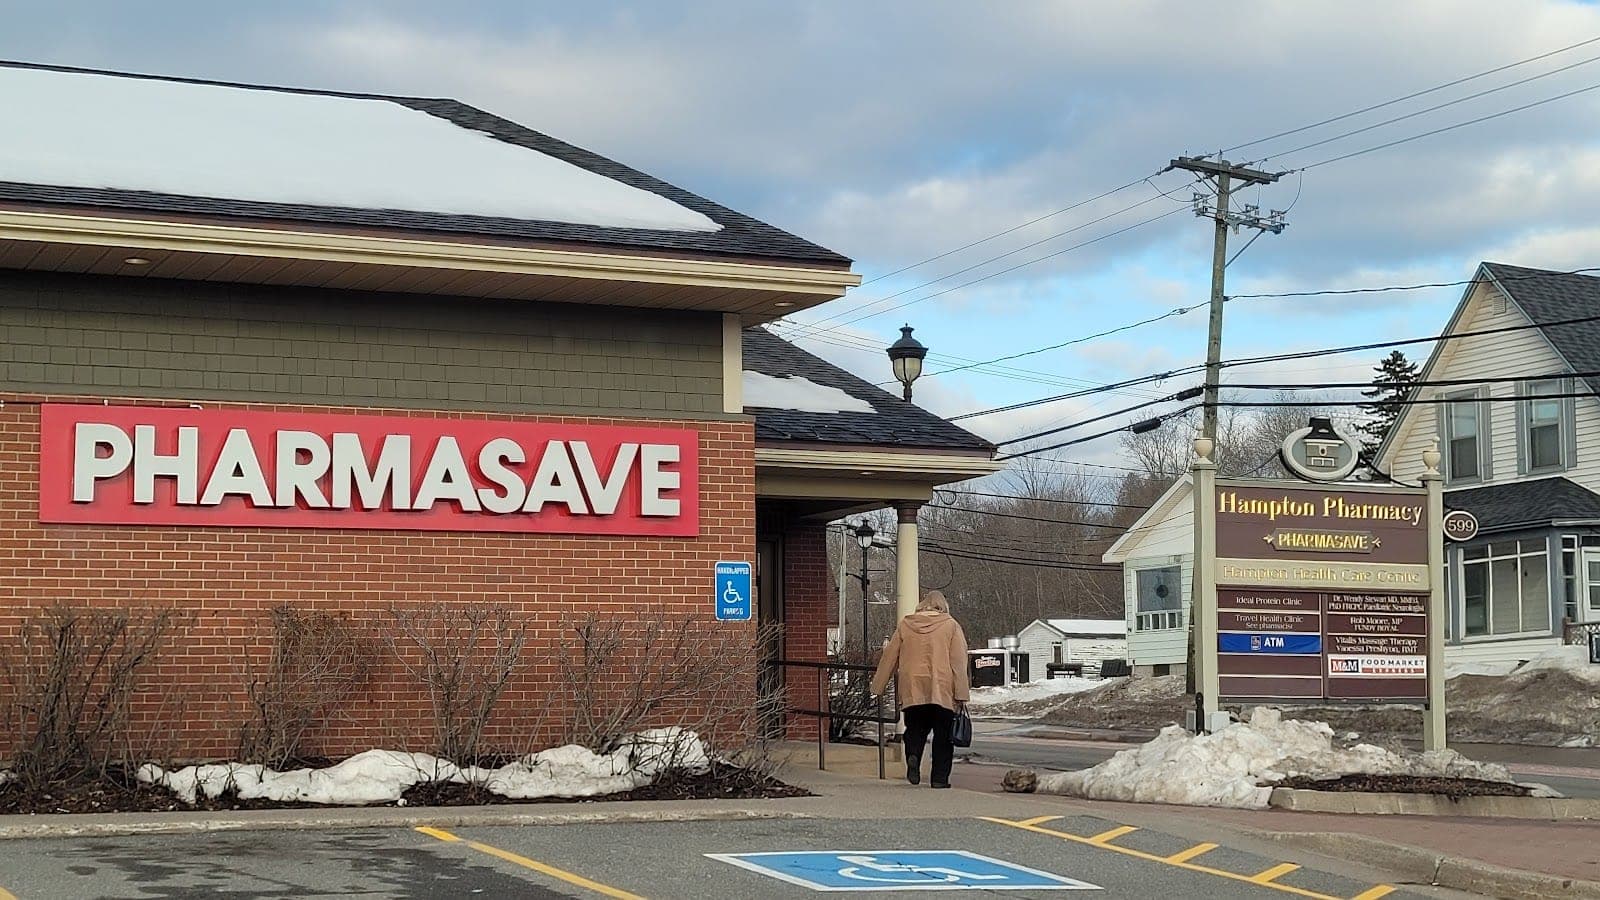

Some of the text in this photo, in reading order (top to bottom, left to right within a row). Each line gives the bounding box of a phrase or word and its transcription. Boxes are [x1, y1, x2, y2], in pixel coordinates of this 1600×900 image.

[72, 422, 680, 517] PHARMASAVE
[1218, 492, 1423, 525] Hampton Pharmacy
[1448, 519, 1474, 532] 599
[1278, 533, 1369, 549] PHARMASAVE
[1223, 565, 1420, 583] Hampton Health Care Centre
[1236, 596, 1254, 604] Ideal
[1256, 597, 1281, 605] Protein
[1343, 595, 1364, 603] Wendy
[1259, 615, 1283, 623] Health
[1259, 622, 1293, 630] pharmacist
[1264, 637, 1285, 648] ATM
[1357, 637, 1388, 646] Massage
[1389, 637, 1418, 646] Therapy
[1331, 659, 1358, 672] M&M
